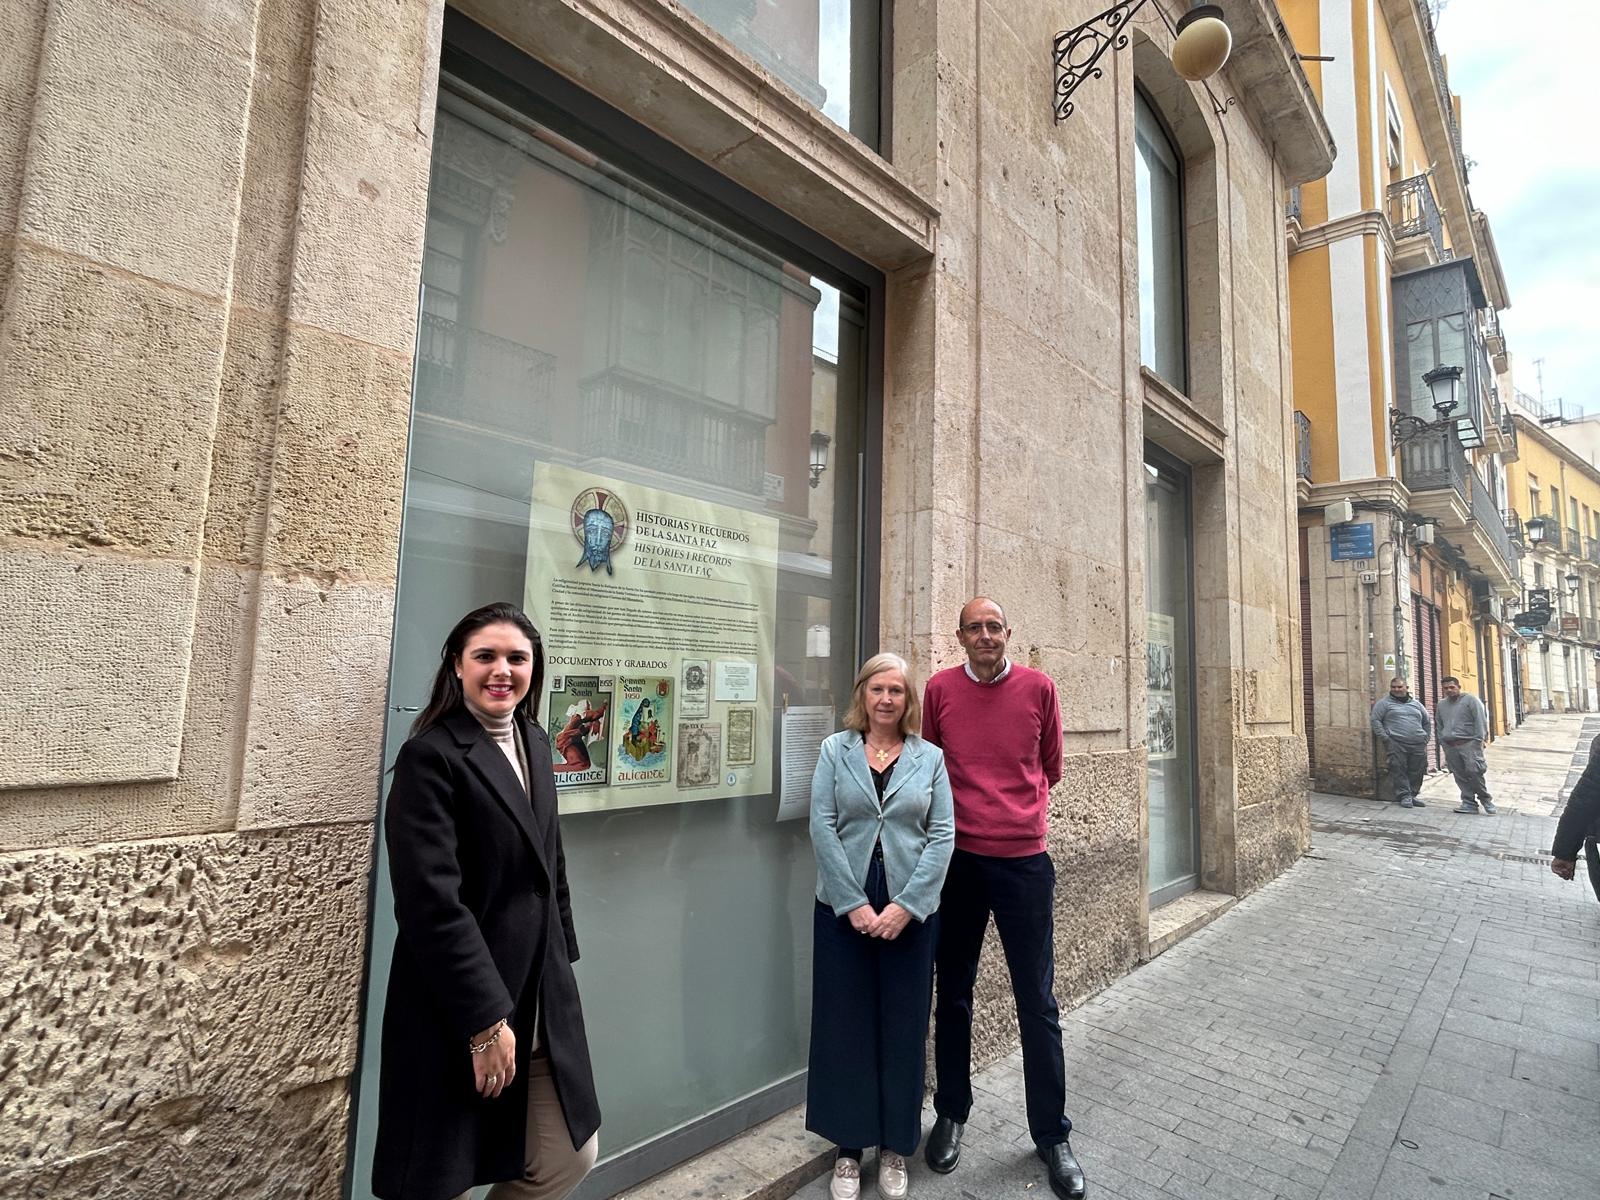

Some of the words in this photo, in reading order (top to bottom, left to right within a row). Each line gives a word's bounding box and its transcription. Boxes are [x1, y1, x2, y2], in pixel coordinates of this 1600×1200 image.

[635, 525, 650, 536] DE
[652, 528, 665, 540] LA
[666, 531, 698, 546] SANTA
[700, 537, 717, 549] FAZ
[636, 511, 689, 531] HISTORIAS
[691, 522, 697, 532] Y
[699, 524, 750, 543] RECUERDOS
[634, 542, 684, 560] HISTÒRIES
[686, 551, 690, 560] I
[692, 552, 732, 567] RECORDS
[633, 556, 648, 567] DE
[649, 558, 662, 569] LA
[663, 560, 694, 574] SANTA
[695, 567, 713, 578] FAÇ
[548, 655, 613, 667] DOCUMENTOS
[616, 659, 622, 667] Y
[624, 659, 668, 669] GRABADOS
[624, 692, 640, 700] 1950
